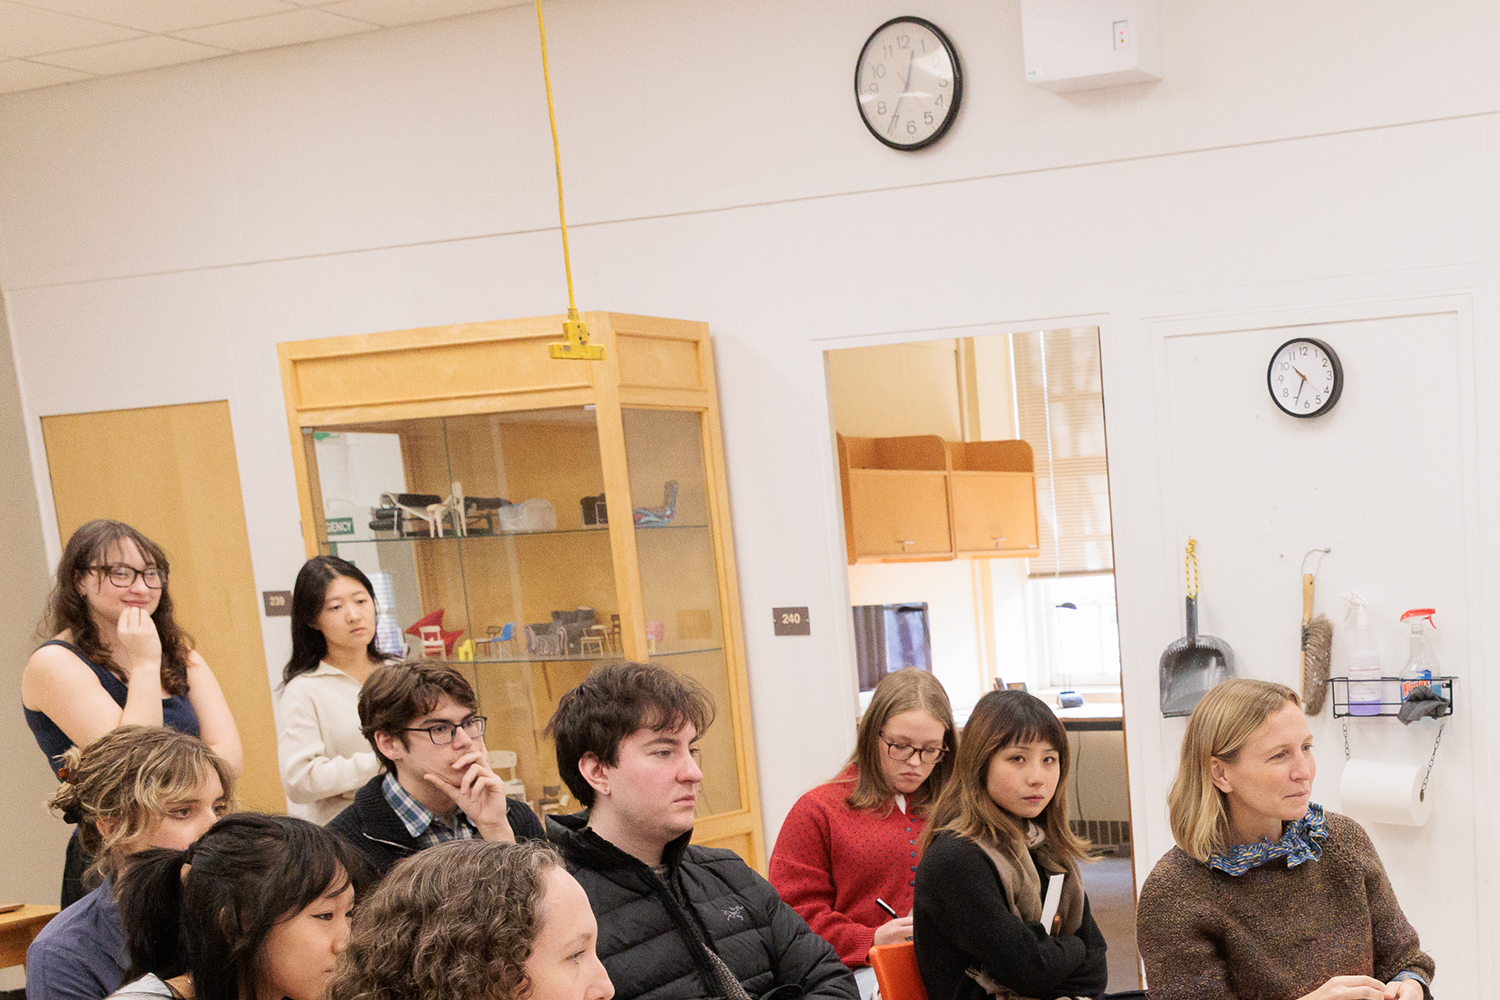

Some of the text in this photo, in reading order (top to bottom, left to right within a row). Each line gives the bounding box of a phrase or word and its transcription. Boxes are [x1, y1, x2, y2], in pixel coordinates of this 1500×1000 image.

[896, 35, 910, 49] 12
[883, 44, 893, 59] 11
[872, 64, 886, 79] 10
[935, 95, 944, 108] 4
[877, 101, 887, 115] 8
[924, 111, 934, 125] 5
[907, 120, 917, 134] 6
[1288, 351, 1296, 361] 11
[1299, 346, 1309, 356] 12
[1280, 362, 1290, 371] 10
[1321, 358, 1328, 368] 2
[1278, 375, 1284, 384] 9
[1326, 370, 1333, 381] 3
[1283, 388, 1289, 398] 8
[1323, 386, 1330, 394] 4
[1304, 399, 1310, 409] 6
[1315, 395, 1322, 405] 5
[782, 613, 801, 624] 240
